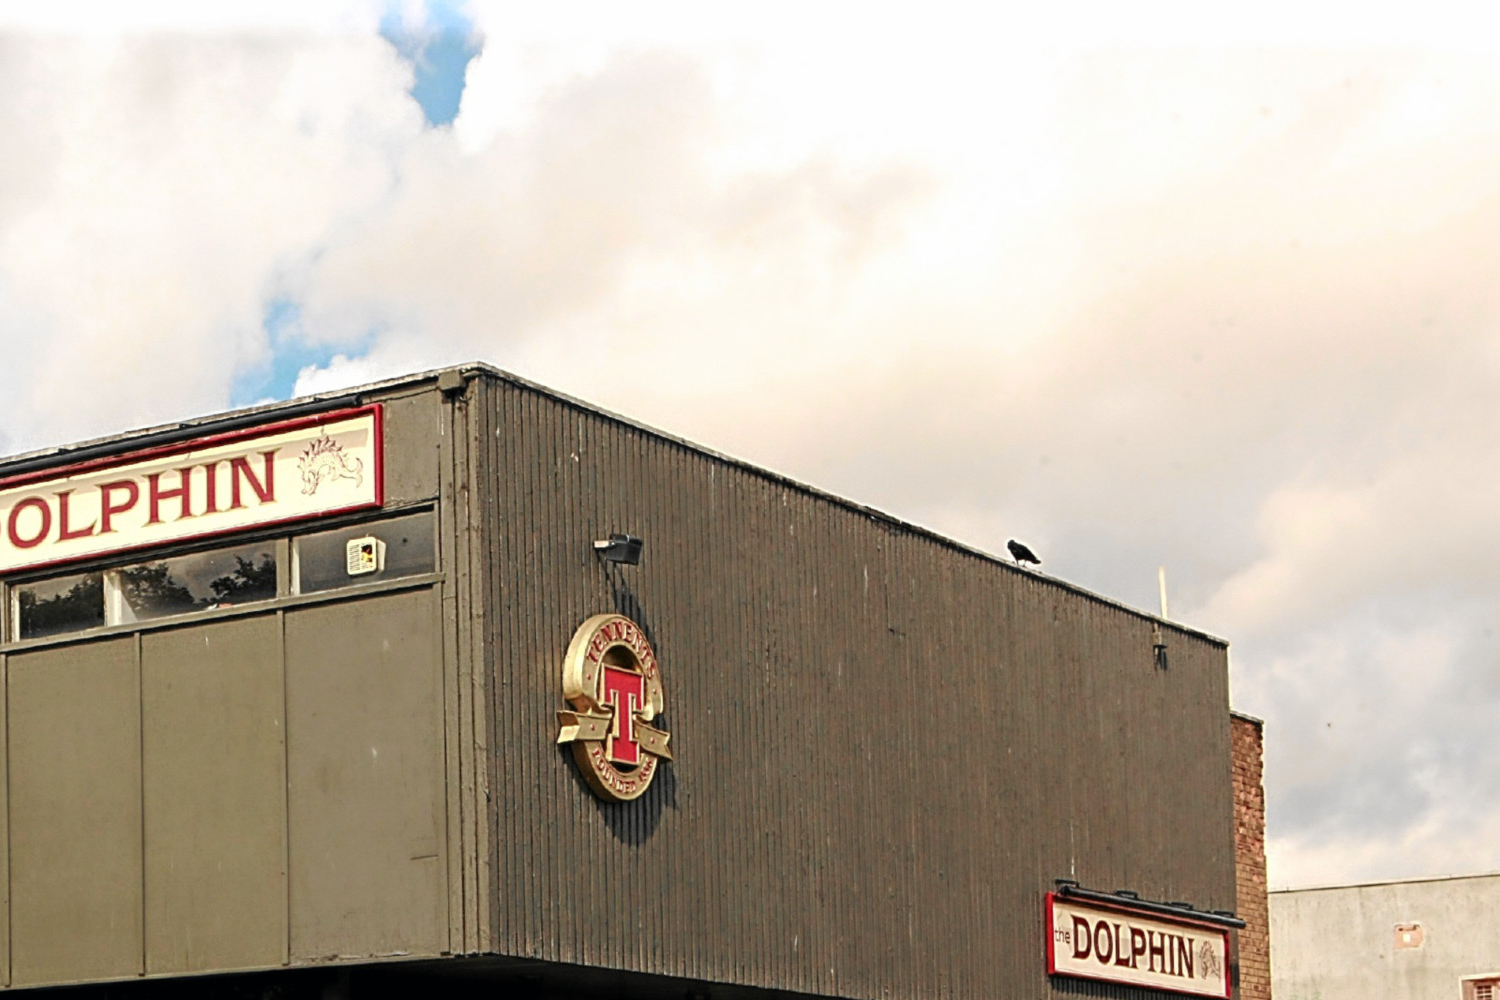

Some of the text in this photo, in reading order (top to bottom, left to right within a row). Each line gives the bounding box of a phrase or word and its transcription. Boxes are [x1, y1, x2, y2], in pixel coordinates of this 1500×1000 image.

[601, 663, 645, 765] T
[1054, 913, 1195, 979] the DOLPHIN
